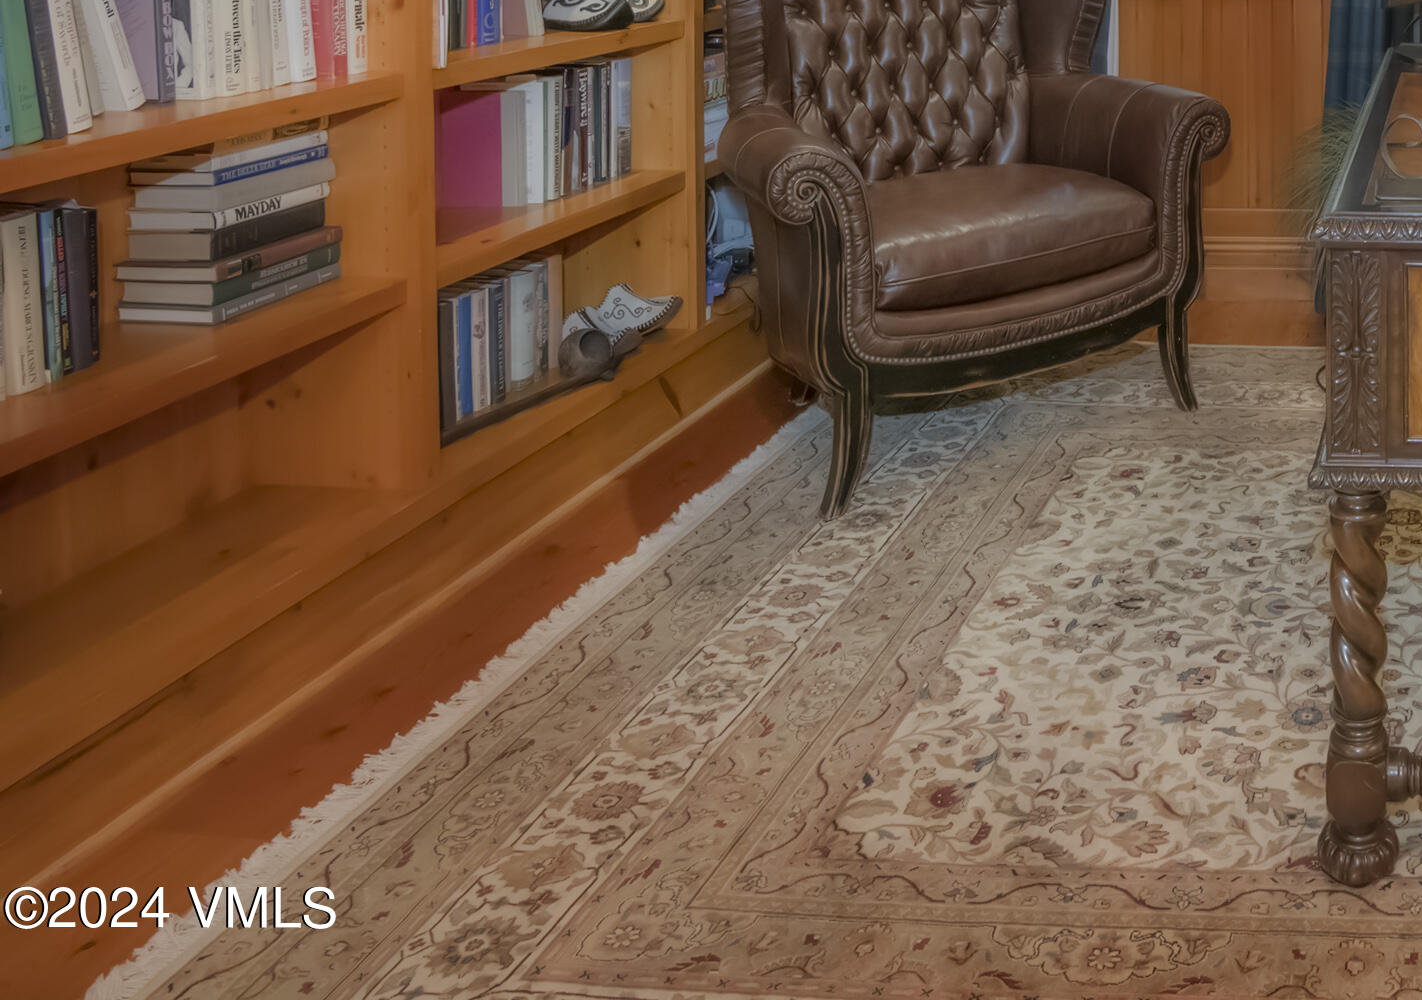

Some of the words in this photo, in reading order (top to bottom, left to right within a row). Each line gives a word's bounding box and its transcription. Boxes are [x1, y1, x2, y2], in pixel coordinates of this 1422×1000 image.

[232, 30, 241, 47] the
[164, 41, 174, 81] BOX
[233, 47, 242, 73] Tates
[235, 196, 282, 221] MAYDAY
